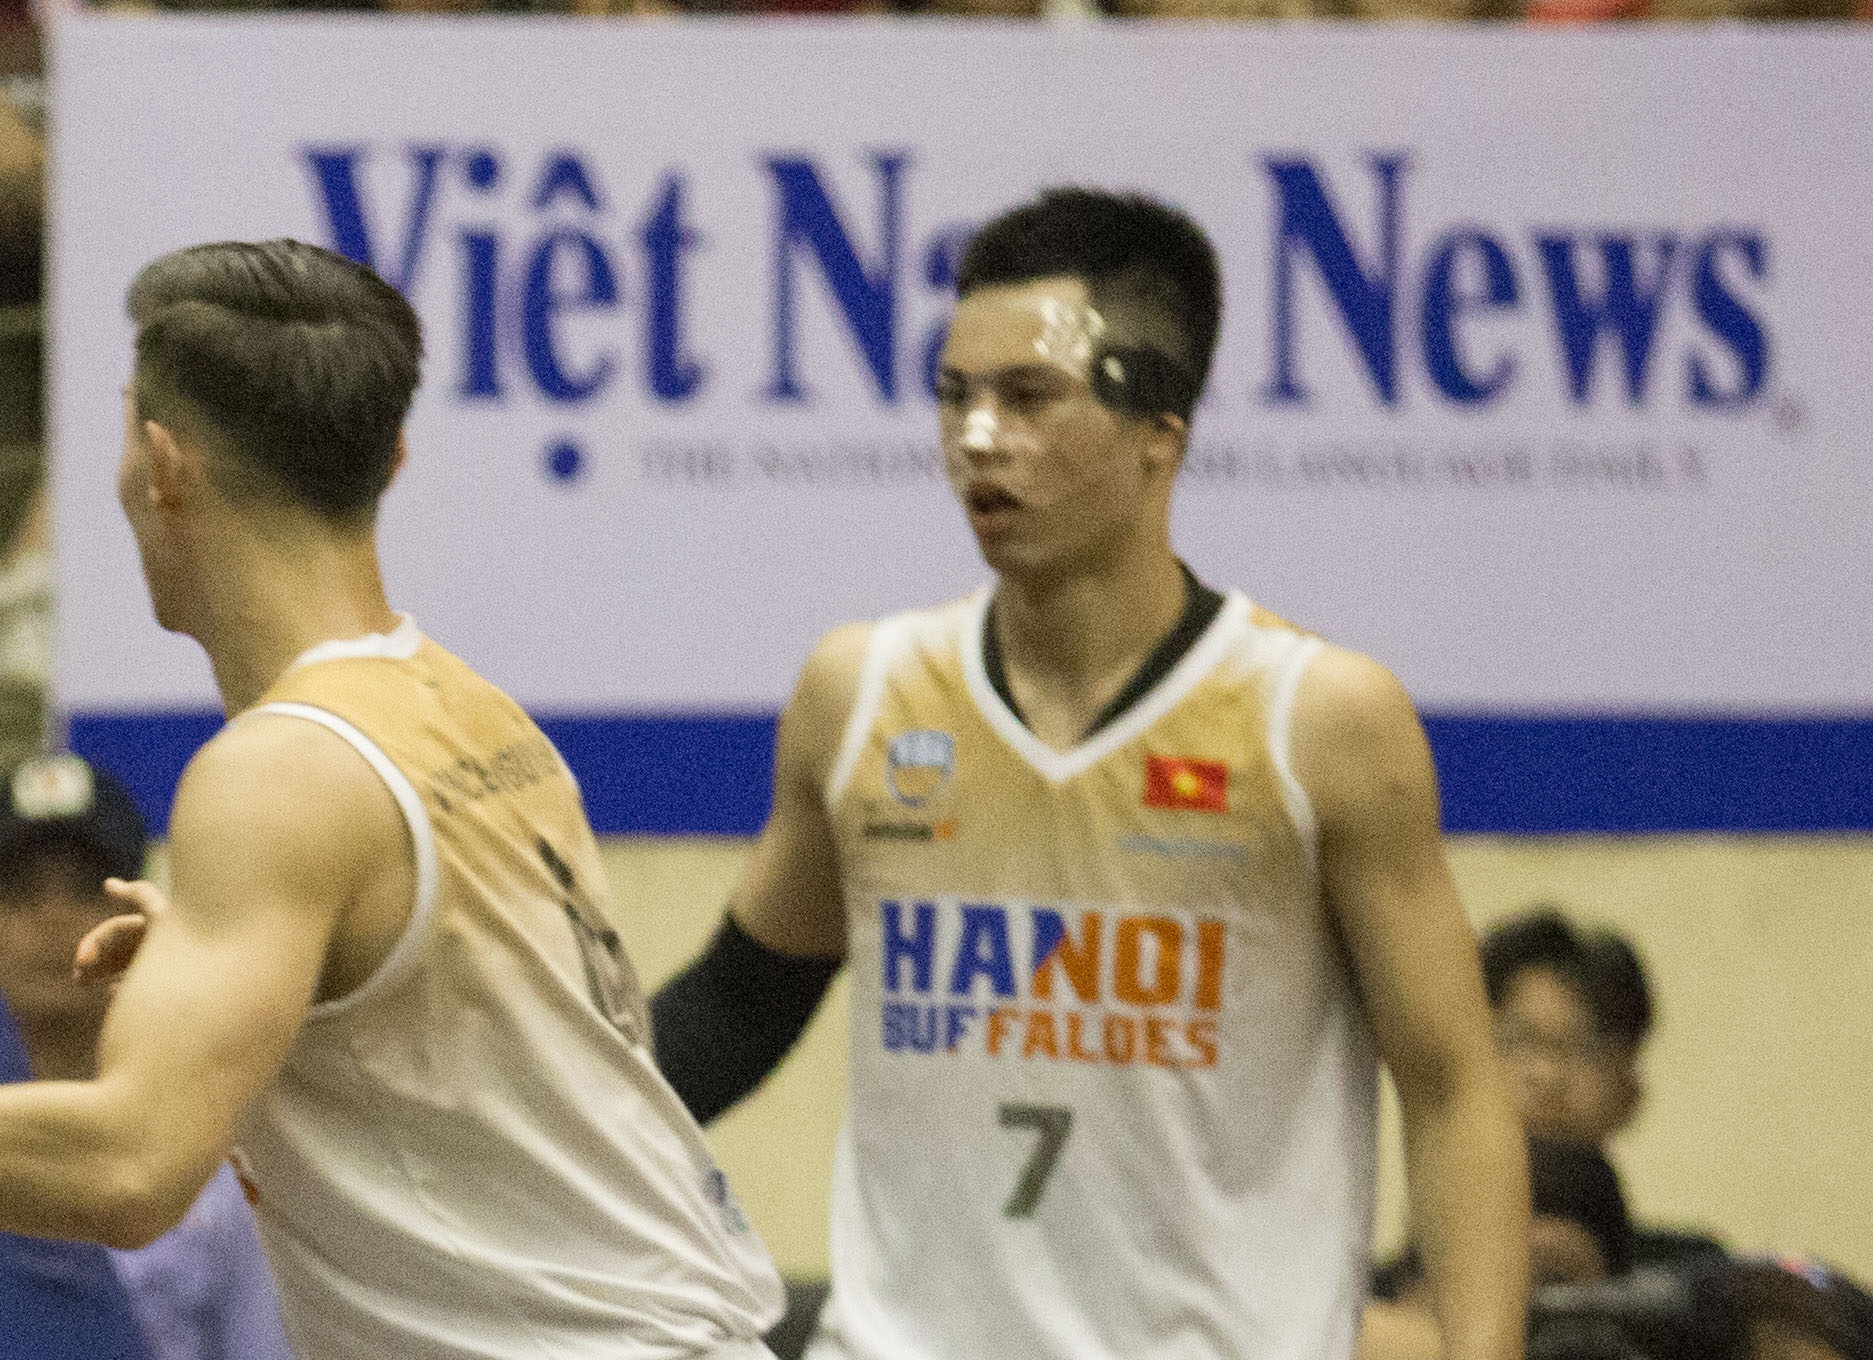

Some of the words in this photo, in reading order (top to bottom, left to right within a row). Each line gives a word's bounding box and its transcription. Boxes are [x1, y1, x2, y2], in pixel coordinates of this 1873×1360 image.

[296, 146, 708, 485] Việt
[1258, 146, 1774, 410] News
[880, 900, 1226, 1012] HANOI
[880, 1002, 1220, 1070] BUFFALOES
[996, 1103, 1075, 1219] 7
